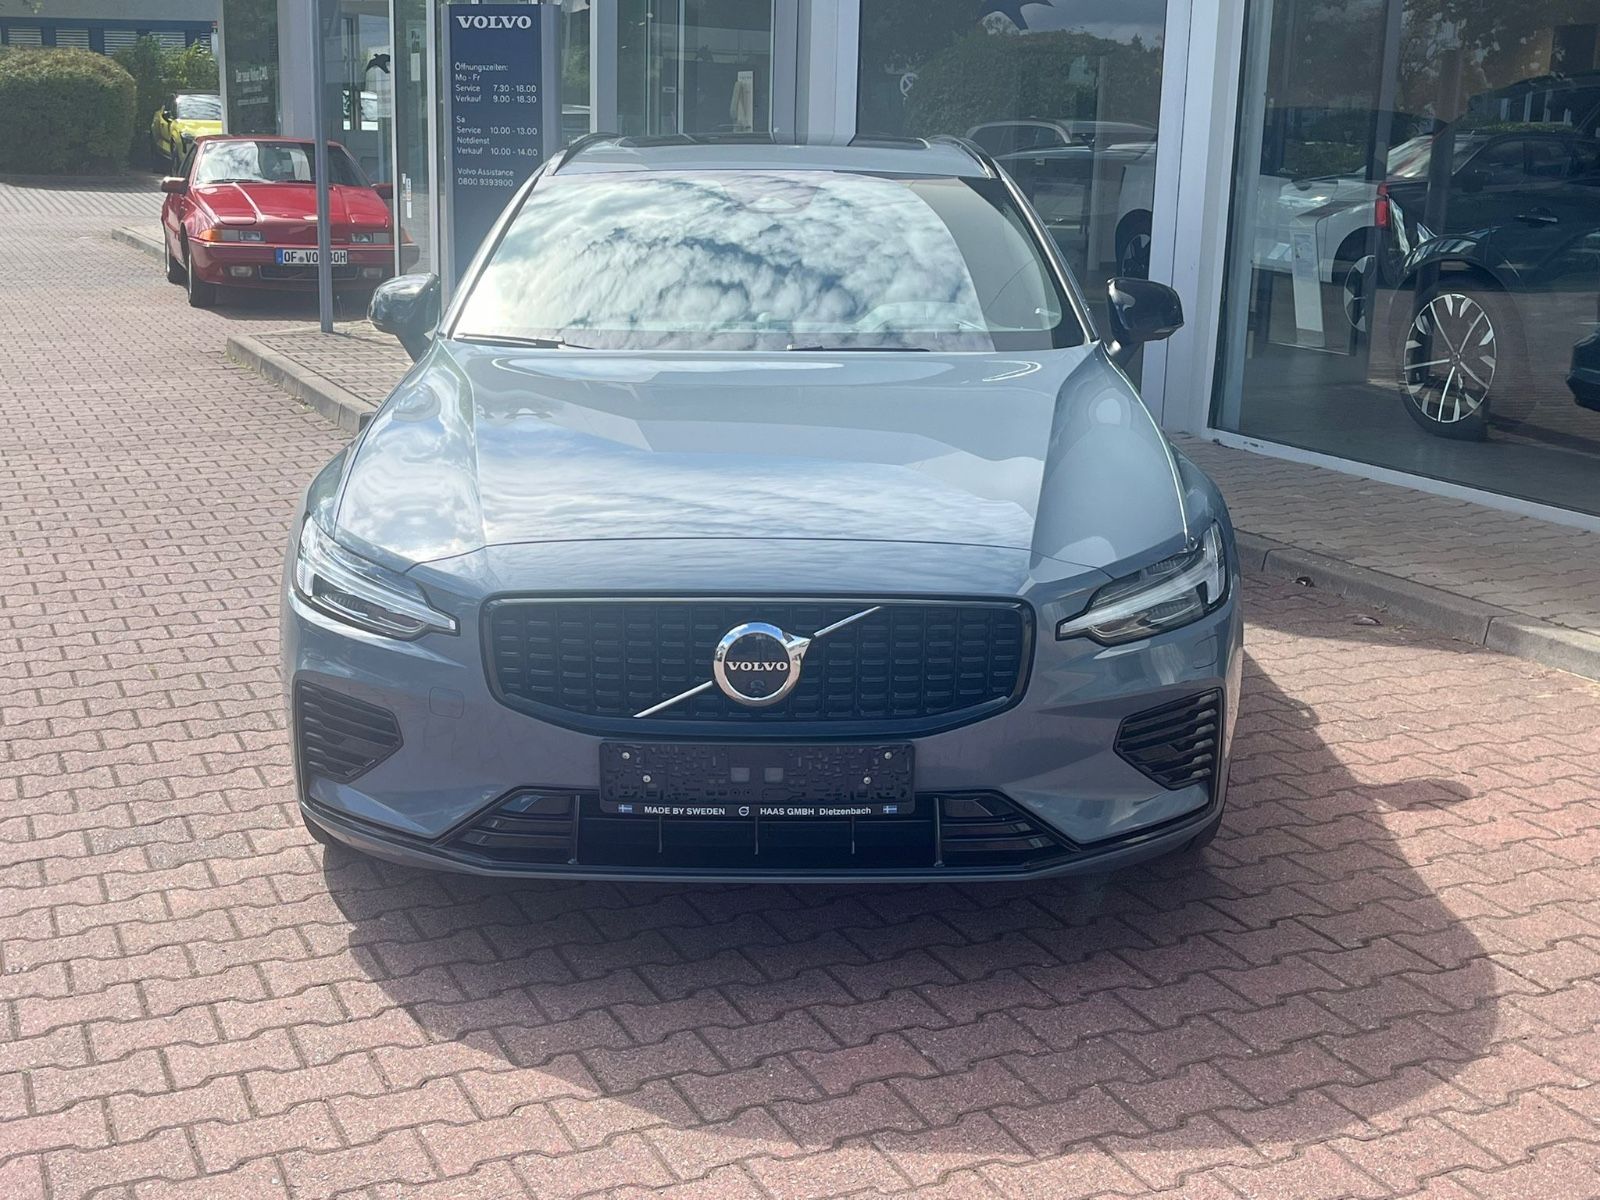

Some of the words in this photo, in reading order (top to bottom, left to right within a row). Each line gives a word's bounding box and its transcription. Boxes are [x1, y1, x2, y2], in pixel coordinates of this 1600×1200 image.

[456, 15, 532, 29] VOLVO
[455, 62, 508, 72] Öffnungszeiten:
[456, 84, 480, 92] Service
[493, 84, 509, 92] 7.30
[493, 95, 510, 103] 9.00
[517, 95, 537, 103] 18.30
[456, 115, 465, 123] Sa
[456, 126, 481, 134] Service
[517, 127, 537, 135] 13.00
[457, 147, 482, 155] Verkauf
[518, 148, 538, 156] 14.00
[457, 168, 476, 176] Volvo
[477, 168, 514, 177] Assistance
[284, 251, 296, 263] OF
[726, 661, 788, 671] VOLVO
[644, 806, 671, 815] MADE
[673, 806, 685, 815] BY
[686, 806, 726, 816] SWEDEN
[760, 806, 785, 816] HAAS
[788, 806, 815, 816] GMBH
[819, 806, 872, 816] Dietzenbach
